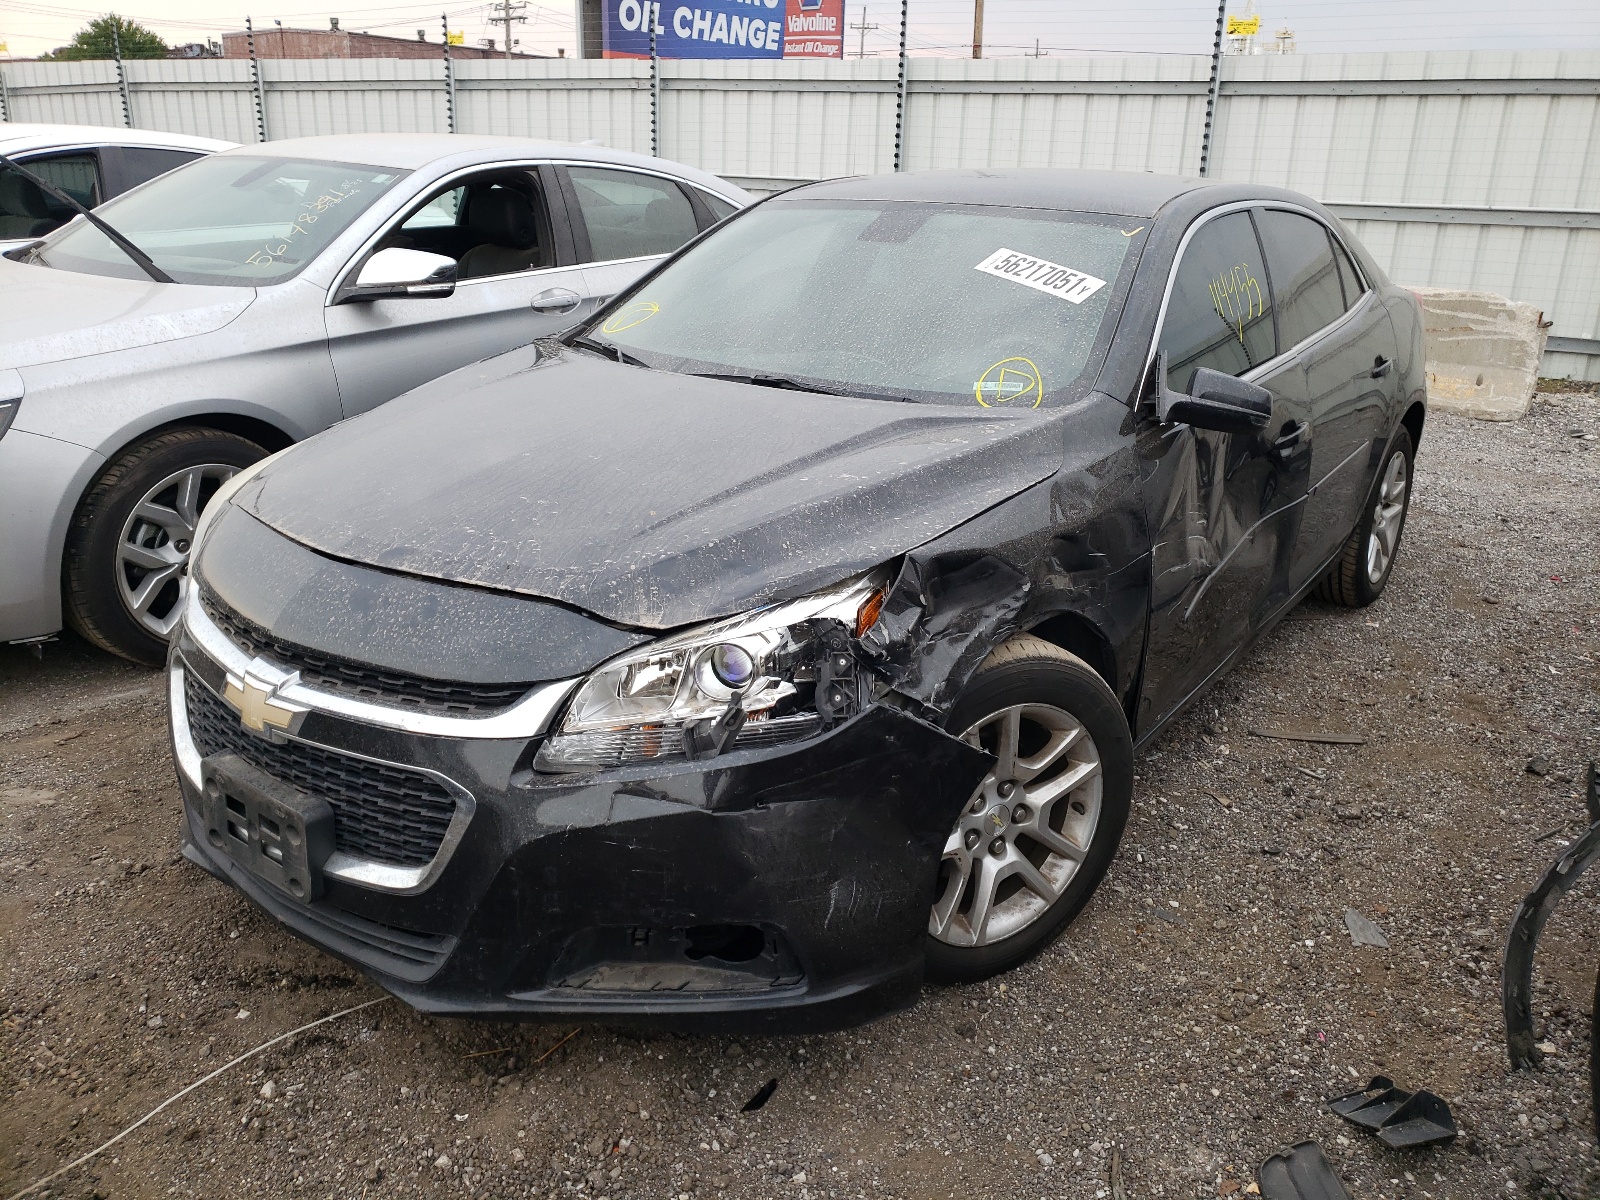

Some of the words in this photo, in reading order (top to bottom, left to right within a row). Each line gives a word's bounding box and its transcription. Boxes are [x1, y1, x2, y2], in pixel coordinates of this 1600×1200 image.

[619, 0, 664, 35] OIL
[673, 6, 781, 51] CHANGE
[788, 13, 837, 32] Valvoline
[784, 42, 804, 53] Instant
[804, 41, 815, 53] Oil
